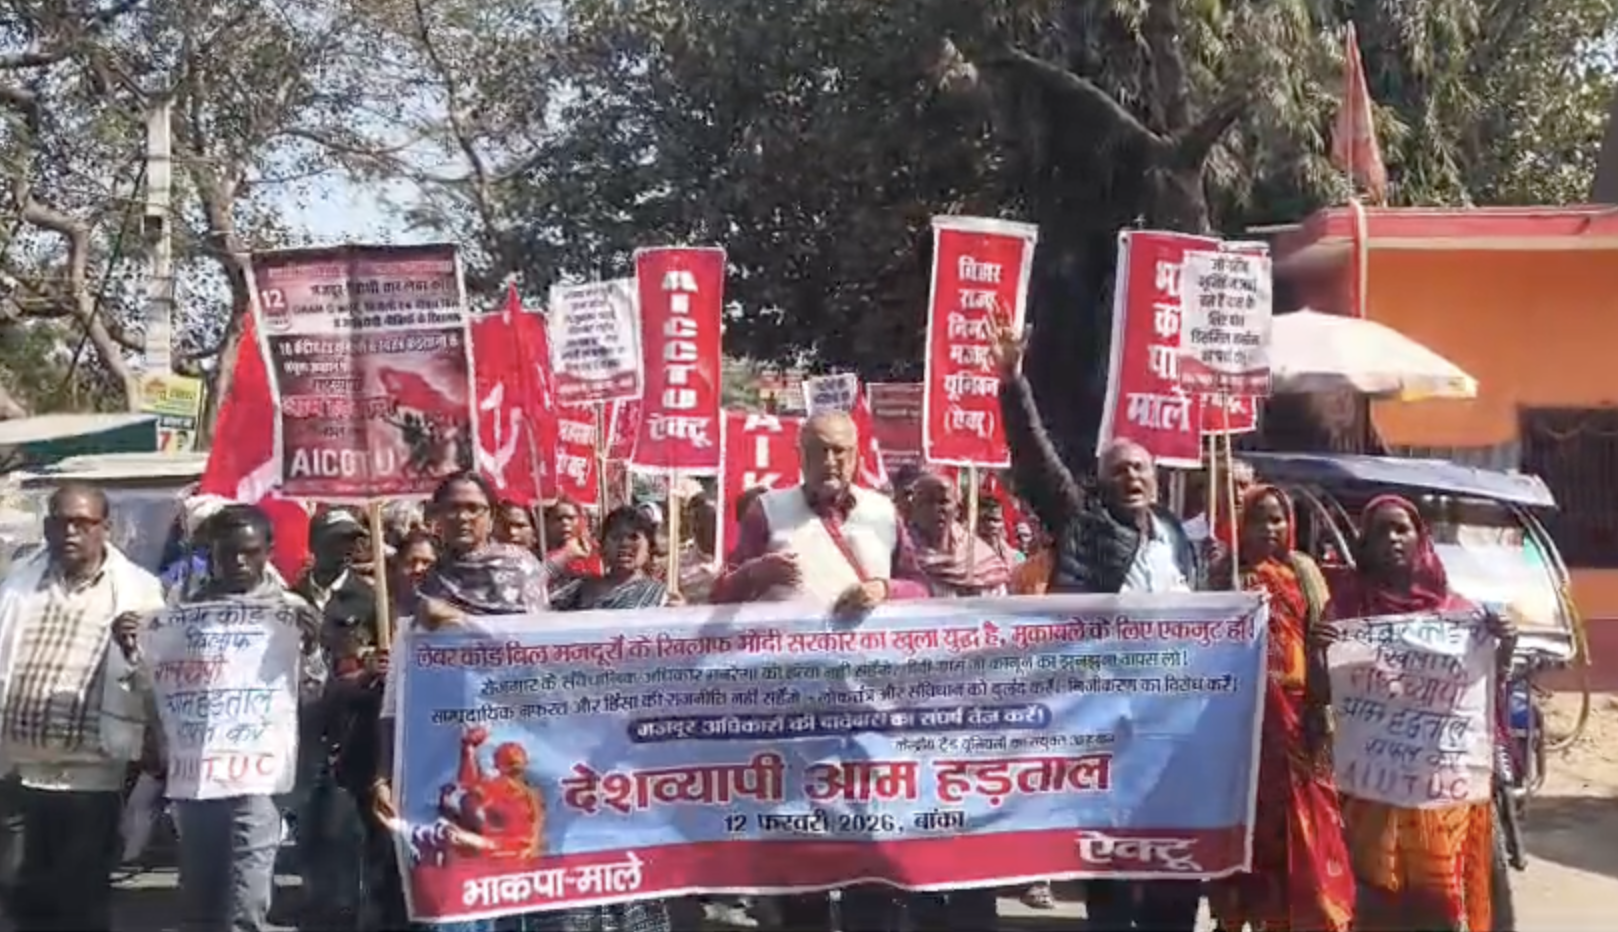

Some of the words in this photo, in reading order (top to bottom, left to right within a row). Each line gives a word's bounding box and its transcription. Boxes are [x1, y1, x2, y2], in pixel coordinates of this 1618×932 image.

[958, 254, 1001, 283] बिहार
[261, 289, 284, 308] 12
[661, 271, 698, 409] AICCTU
[1126, 385, 1192, 432] माले
[646, 413, 713, 448] ऐक्टू
[417, 642, 456, 668] लेबर
[461, 642, 504, 667] कोड
[506, 640, 547, 666] बिल
[552, 635, 624, 667] मजदूरों
[629, 639, 652, 660] के
[657, 632, 731, 658] खिलाफ
[737, 628, 781, 653] मोदी
[786, 631, 856, 654] सरकार
[859, 630, 886, 651] का
[891, 628, 939, 655] खुला
[942, 627, 980, 652] युद्ध
[981, 620, 1007, 649] है,
[1012, 618, 1085, 651] मुकाबले
[1088, 617, 1110, 640] के
[1115, 615, 1153, 641] लिए
[1158, 618, 1223, 645] एकजुट
[541, 673, 557, 692] के
[1037, 654, 1056, 671] का
[519, 702, 568, 719] नफरत
[575, 697, 600, 714] और
[641, 690, 663, 707] की
[880, 682, 903, 700] और
[908, 680, 962, 698] संविधान
[967, 678, 987, 696] को
[1067, 674, 1137, 693] निजीकरण
[1141, 676, 1161, 692] का
[1165, 673, 1203, 693] विरोध
[637, 719, 697, 738] मजदूर
[789, 713, 816, 731] की
[890, 710, 914, 726] का
[920, 707, 964, 726] संघर्ष
[968, 707, 1001, 725] तेज
[561, 752, 787, 817] देशव्यापी
[804, 758, 919, 804] आम
[933, 751, 1114, 808] हड़ताल
[724, 814, 747, 832] 12
[758, 810, 828, 833] फरवरी
[914, 808, 966, 831] बांका
[1075, 830, 1203, 872] ऐक्टू
[462, 850, 646, 908] भाकपा-माले
